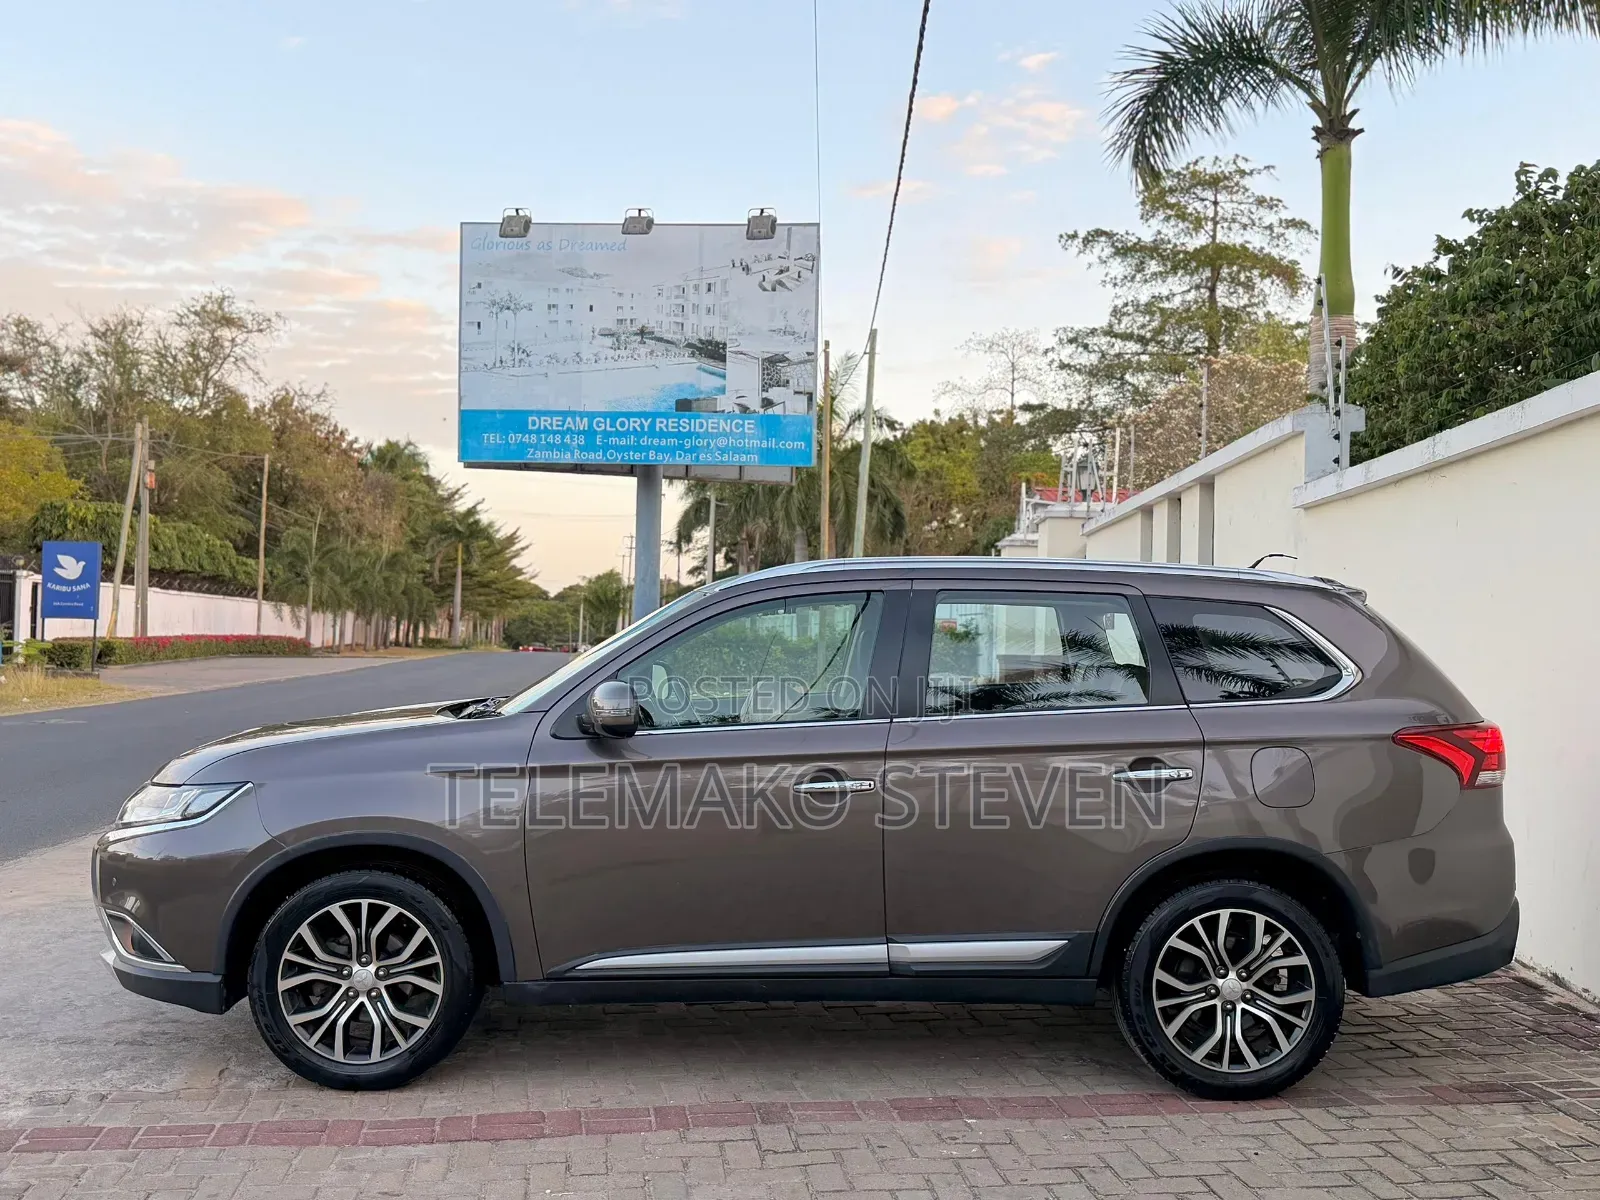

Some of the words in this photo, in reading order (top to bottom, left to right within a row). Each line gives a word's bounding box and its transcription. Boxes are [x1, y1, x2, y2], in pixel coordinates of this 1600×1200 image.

[470, 232, 531, 251] Glorious
[536, 240, 552, 251] as
[558, 238, 628, 251] Dreamed
[527, 416, 589, 431] DREAM
[592, 417, 652, 432] GLORY
[655, 417, 756, 433] RESIDENCE
[482, 433, 506, 444] TEL:
[508, 433, 537, 444] 0748
[540, 433, 561, 445] 148
[563, 434, 585, 445] 438
[596, 434, 637, 446] E-mail:
[640, 434, 805, 449] dream-glory@hotmail.com
[526, 448, 571, 460] Zambia
[648, 450, 673, 463] Bay,
[675, 451, 699, 462] Dar
[699, 454, 712, 462] es
[714, 451, 758, 463] Salaam
[46, 582, 72, 592] KARIBU
[72, 582, 91, 592] SANA
